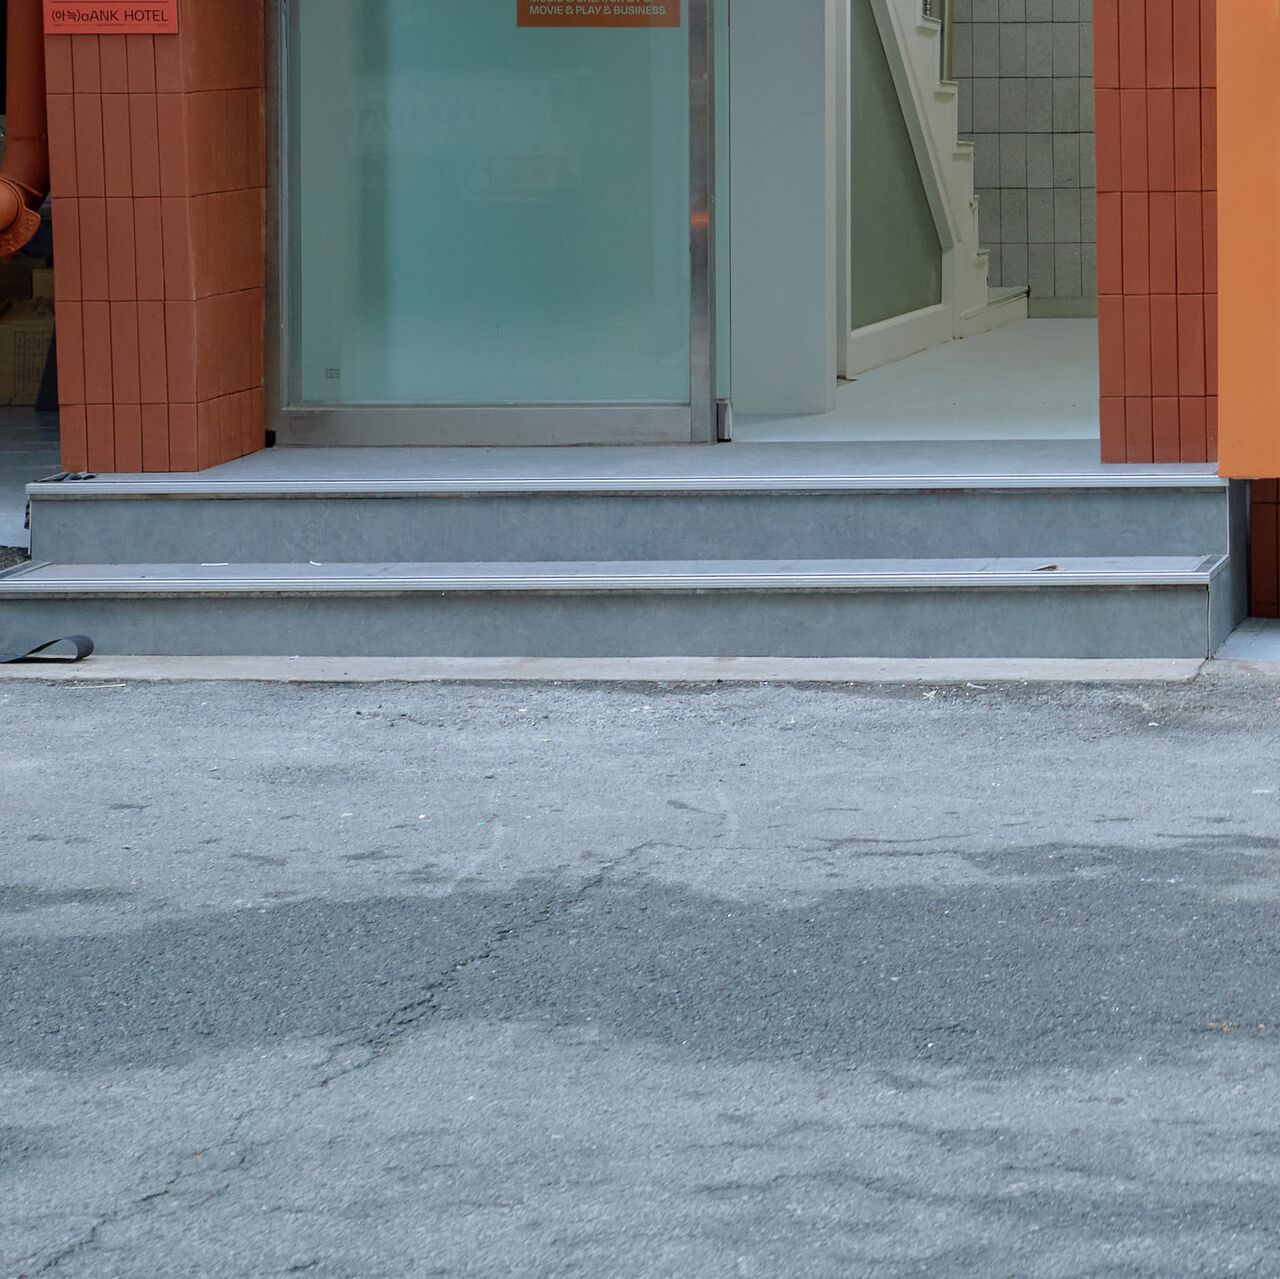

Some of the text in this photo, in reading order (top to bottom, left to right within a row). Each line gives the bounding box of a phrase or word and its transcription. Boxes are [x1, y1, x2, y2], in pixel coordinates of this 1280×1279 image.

[529, 6, 563, 14] MOVIE
[576, 6, 600, 14] PLAY
[124, 10, 168, 22] HOTEL
